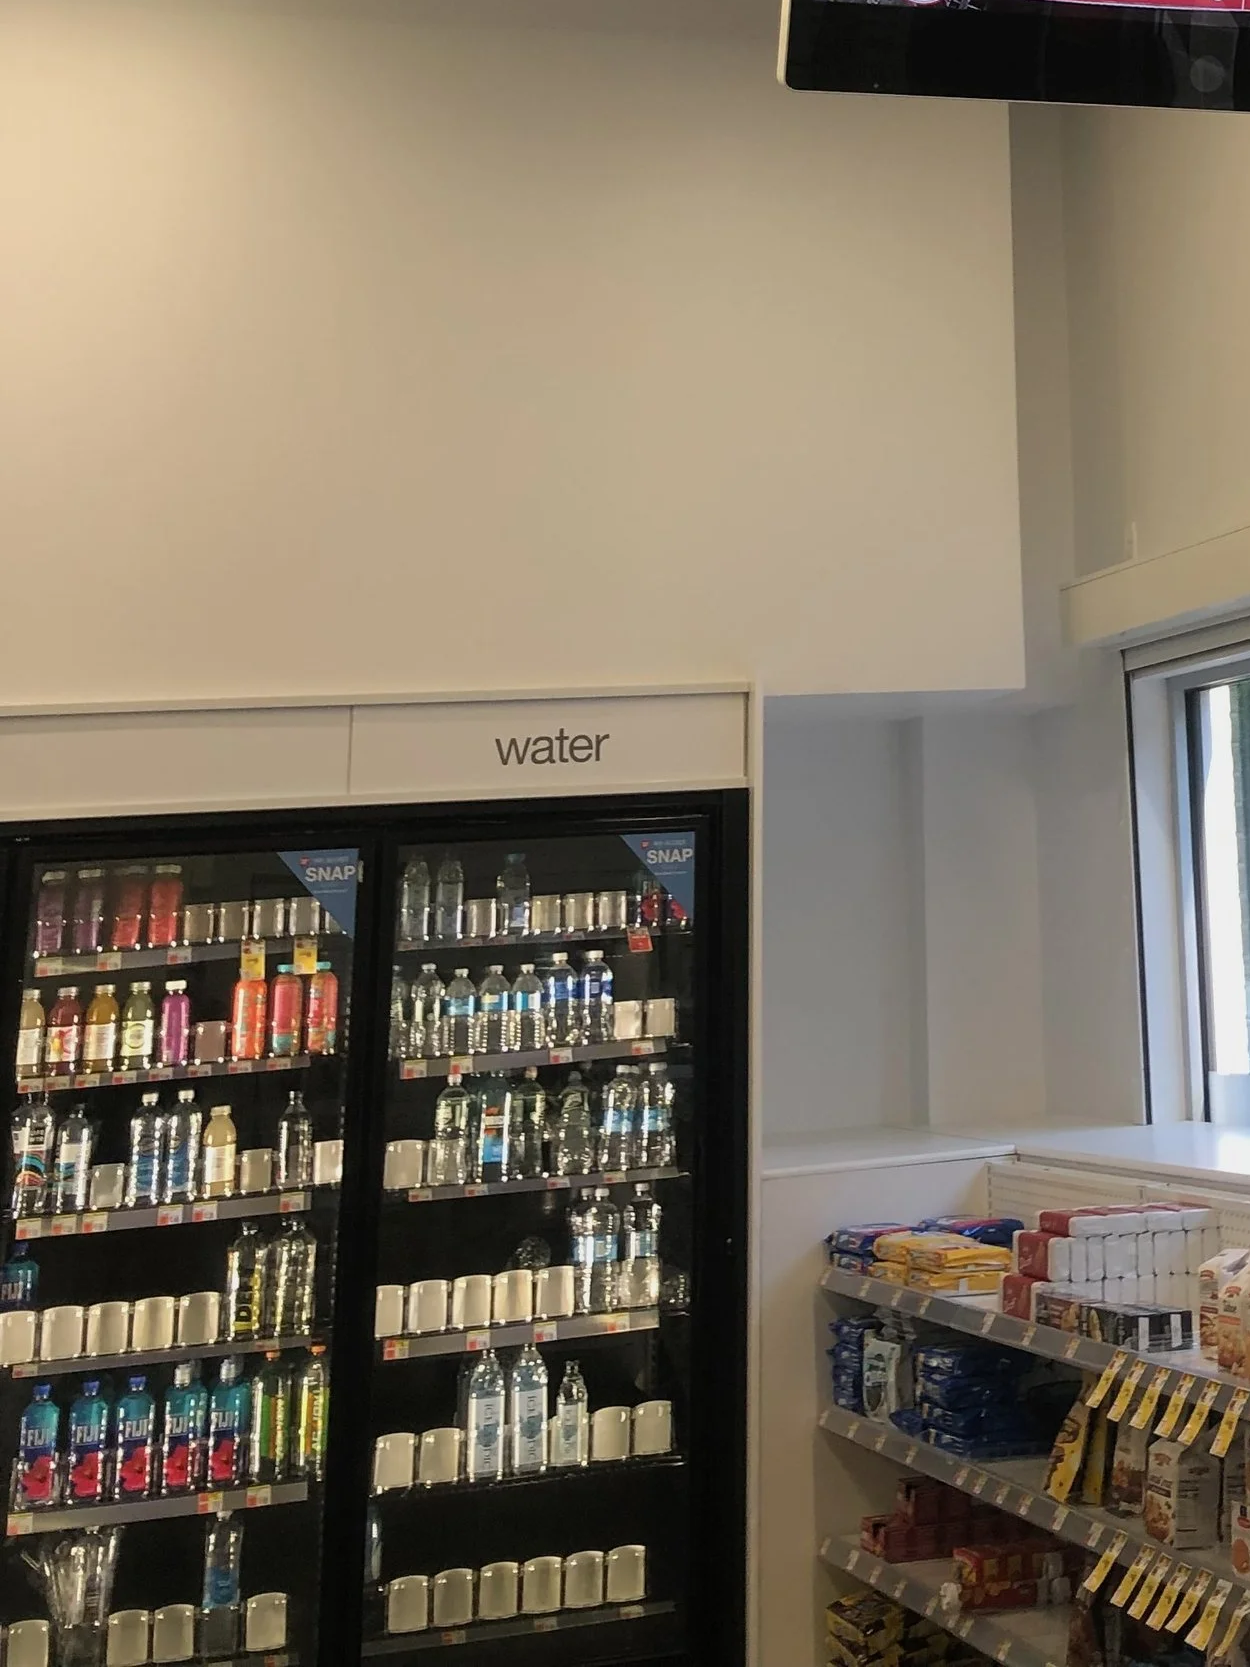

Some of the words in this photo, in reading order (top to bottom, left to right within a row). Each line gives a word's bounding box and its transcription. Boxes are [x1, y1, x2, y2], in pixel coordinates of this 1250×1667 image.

[495, 728, 610, 766] water
[646, 848, 694, 864] SNAP
[304, 864, 356, 882] SNAP
[124, 1418, 150, 1438] FIJI
[211, 1410, 234, 1432] FIJI
[75, 1424, 100, 1444] FIJI
